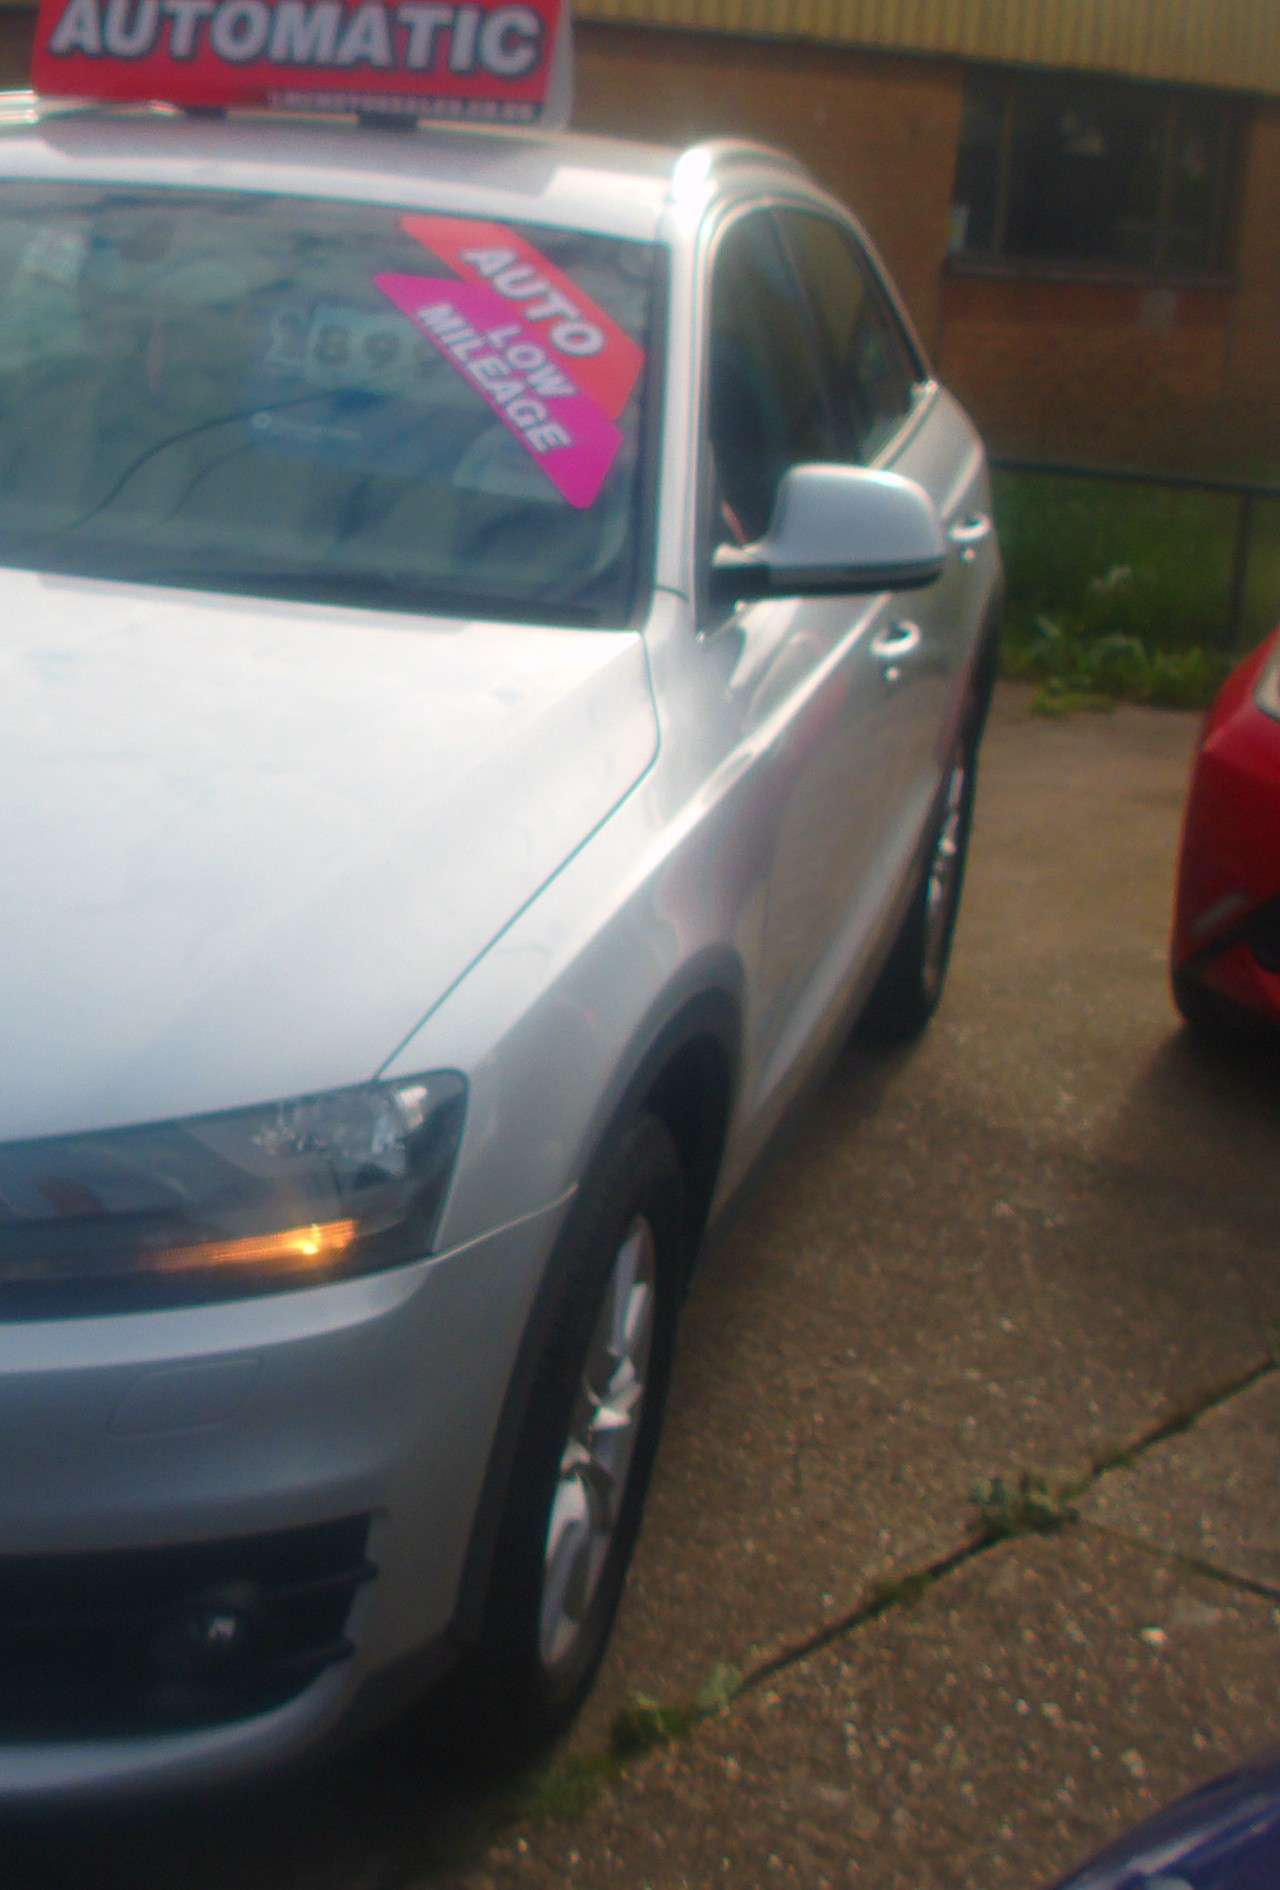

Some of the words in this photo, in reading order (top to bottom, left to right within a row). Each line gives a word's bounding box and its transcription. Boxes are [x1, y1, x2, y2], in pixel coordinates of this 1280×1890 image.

[48, 0, 544, 76] AUTOMATIC
[460, 246, 604, 356] AUTO
[417, 302, 573, 453] MILEAGE
[487, 323, 578, 399] LOW
